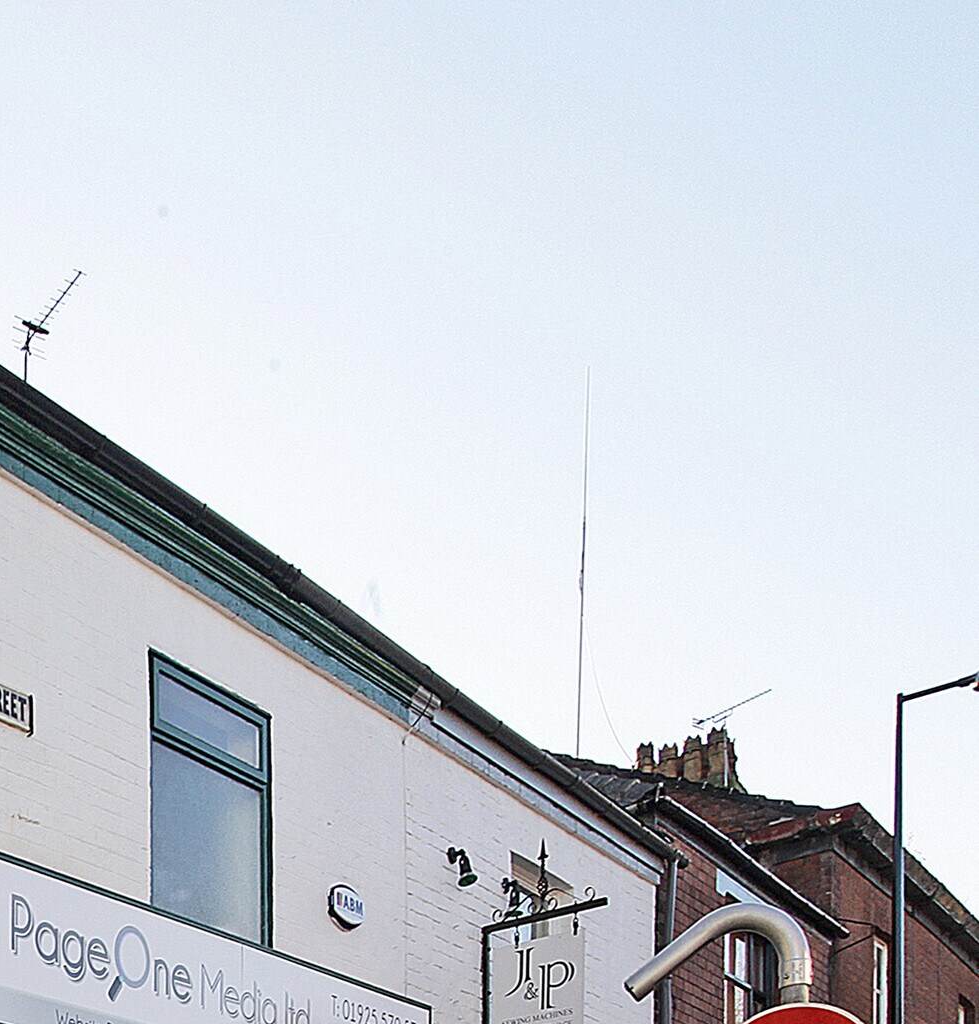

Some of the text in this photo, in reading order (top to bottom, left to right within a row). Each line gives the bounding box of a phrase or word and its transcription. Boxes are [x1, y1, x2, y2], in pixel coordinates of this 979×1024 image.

[343, 894, 364, 916] ABM
[11, 893, 192, 1004] PageOne
[504, 946, 575, 1010] J&P
[331, 995, 340, 1017] T:
[533, 1008, 574, 1022] MACHINES
